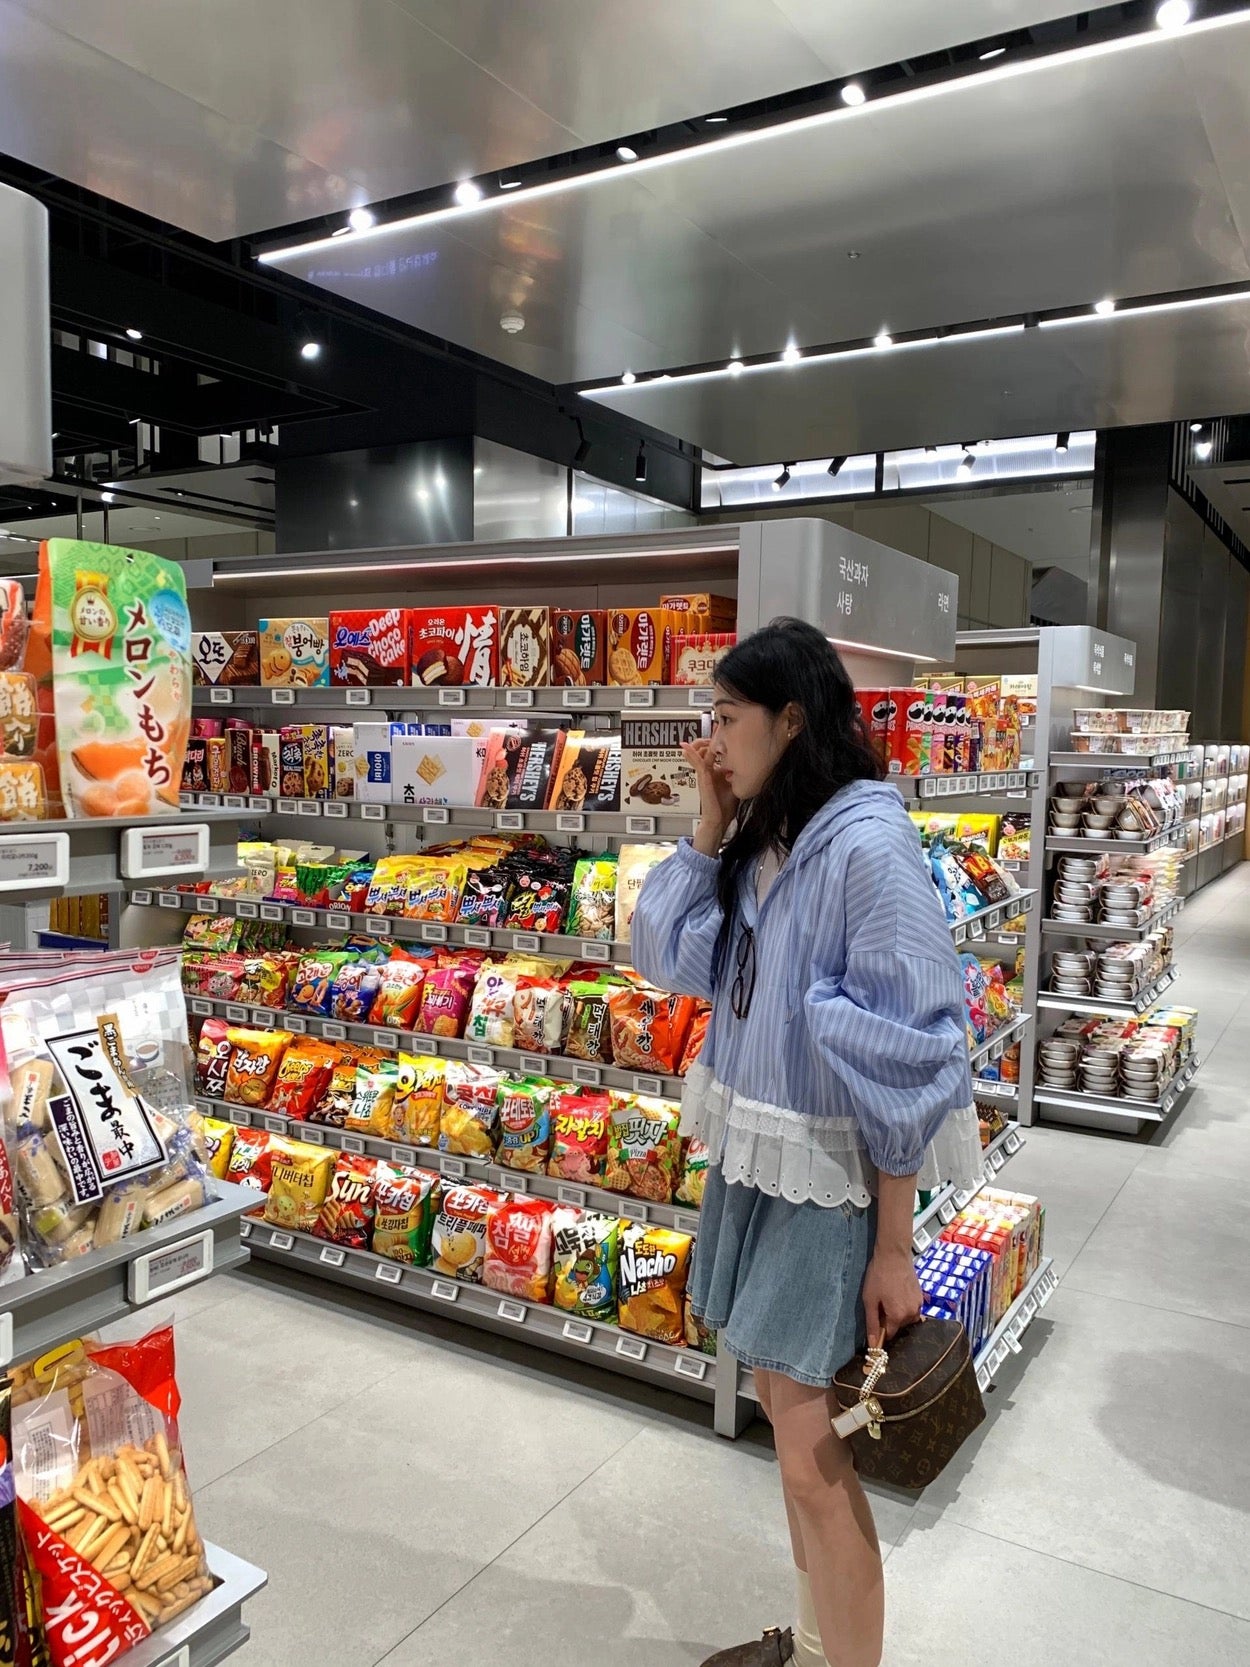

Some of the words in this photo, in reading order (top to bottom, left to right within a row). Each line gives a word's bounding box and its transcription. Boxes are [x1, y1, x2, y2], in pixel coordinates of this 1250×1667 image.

[839, 556, 869, 587] 국산과자
[81, 605, 106, 615] メロンの
[836, 592, 853, 615] 사탕
[938, 592, 950, 613] 라면
[368, 608, 401, 637] Deep
[419, 627, 455, 641] 초코파이
[427, 618, 446, 626] 오리온
[333, 628, 372, 648] 오예스
[579, 613, 591, 670] 마가렛트
[637, 612, 649, 670] 마가렛트
[380, 640, 405, 667] cake
[126, 599, 170, 786] メロンもち
[625, 721, 698, 746] HERSHEY'S
[235, 731, 248, 767] Binch
[271, 751, 279, 780] Market
[519, 741, 546, 802] HERSHEY'S
[586, 1003, 607, 1057] 먹태깡
[636, 1000, 655, 1054] 새우깡
[206, 1040, 232, 1094] 오사쯔
[66, 1041, 136, 1160] ごま最中
[500, 1097, 535, 1122] 포테토칩
[519, 1130, 535, 1144] UP
[555, 1114, 605, 1142] 자갈치
[623, 1117, 668, 1146] 핏자
[630, 1149, 647, 1159] Pizza
[322, 1170, 371, 1204] Sun
[376, 1180, 416, 1212] 포카칩
[620, 1247, 677, 1287] Nacho
[630, 1280, 647, 1297] 나초
[36, 1531, 147, 1646] スティックビスケット
